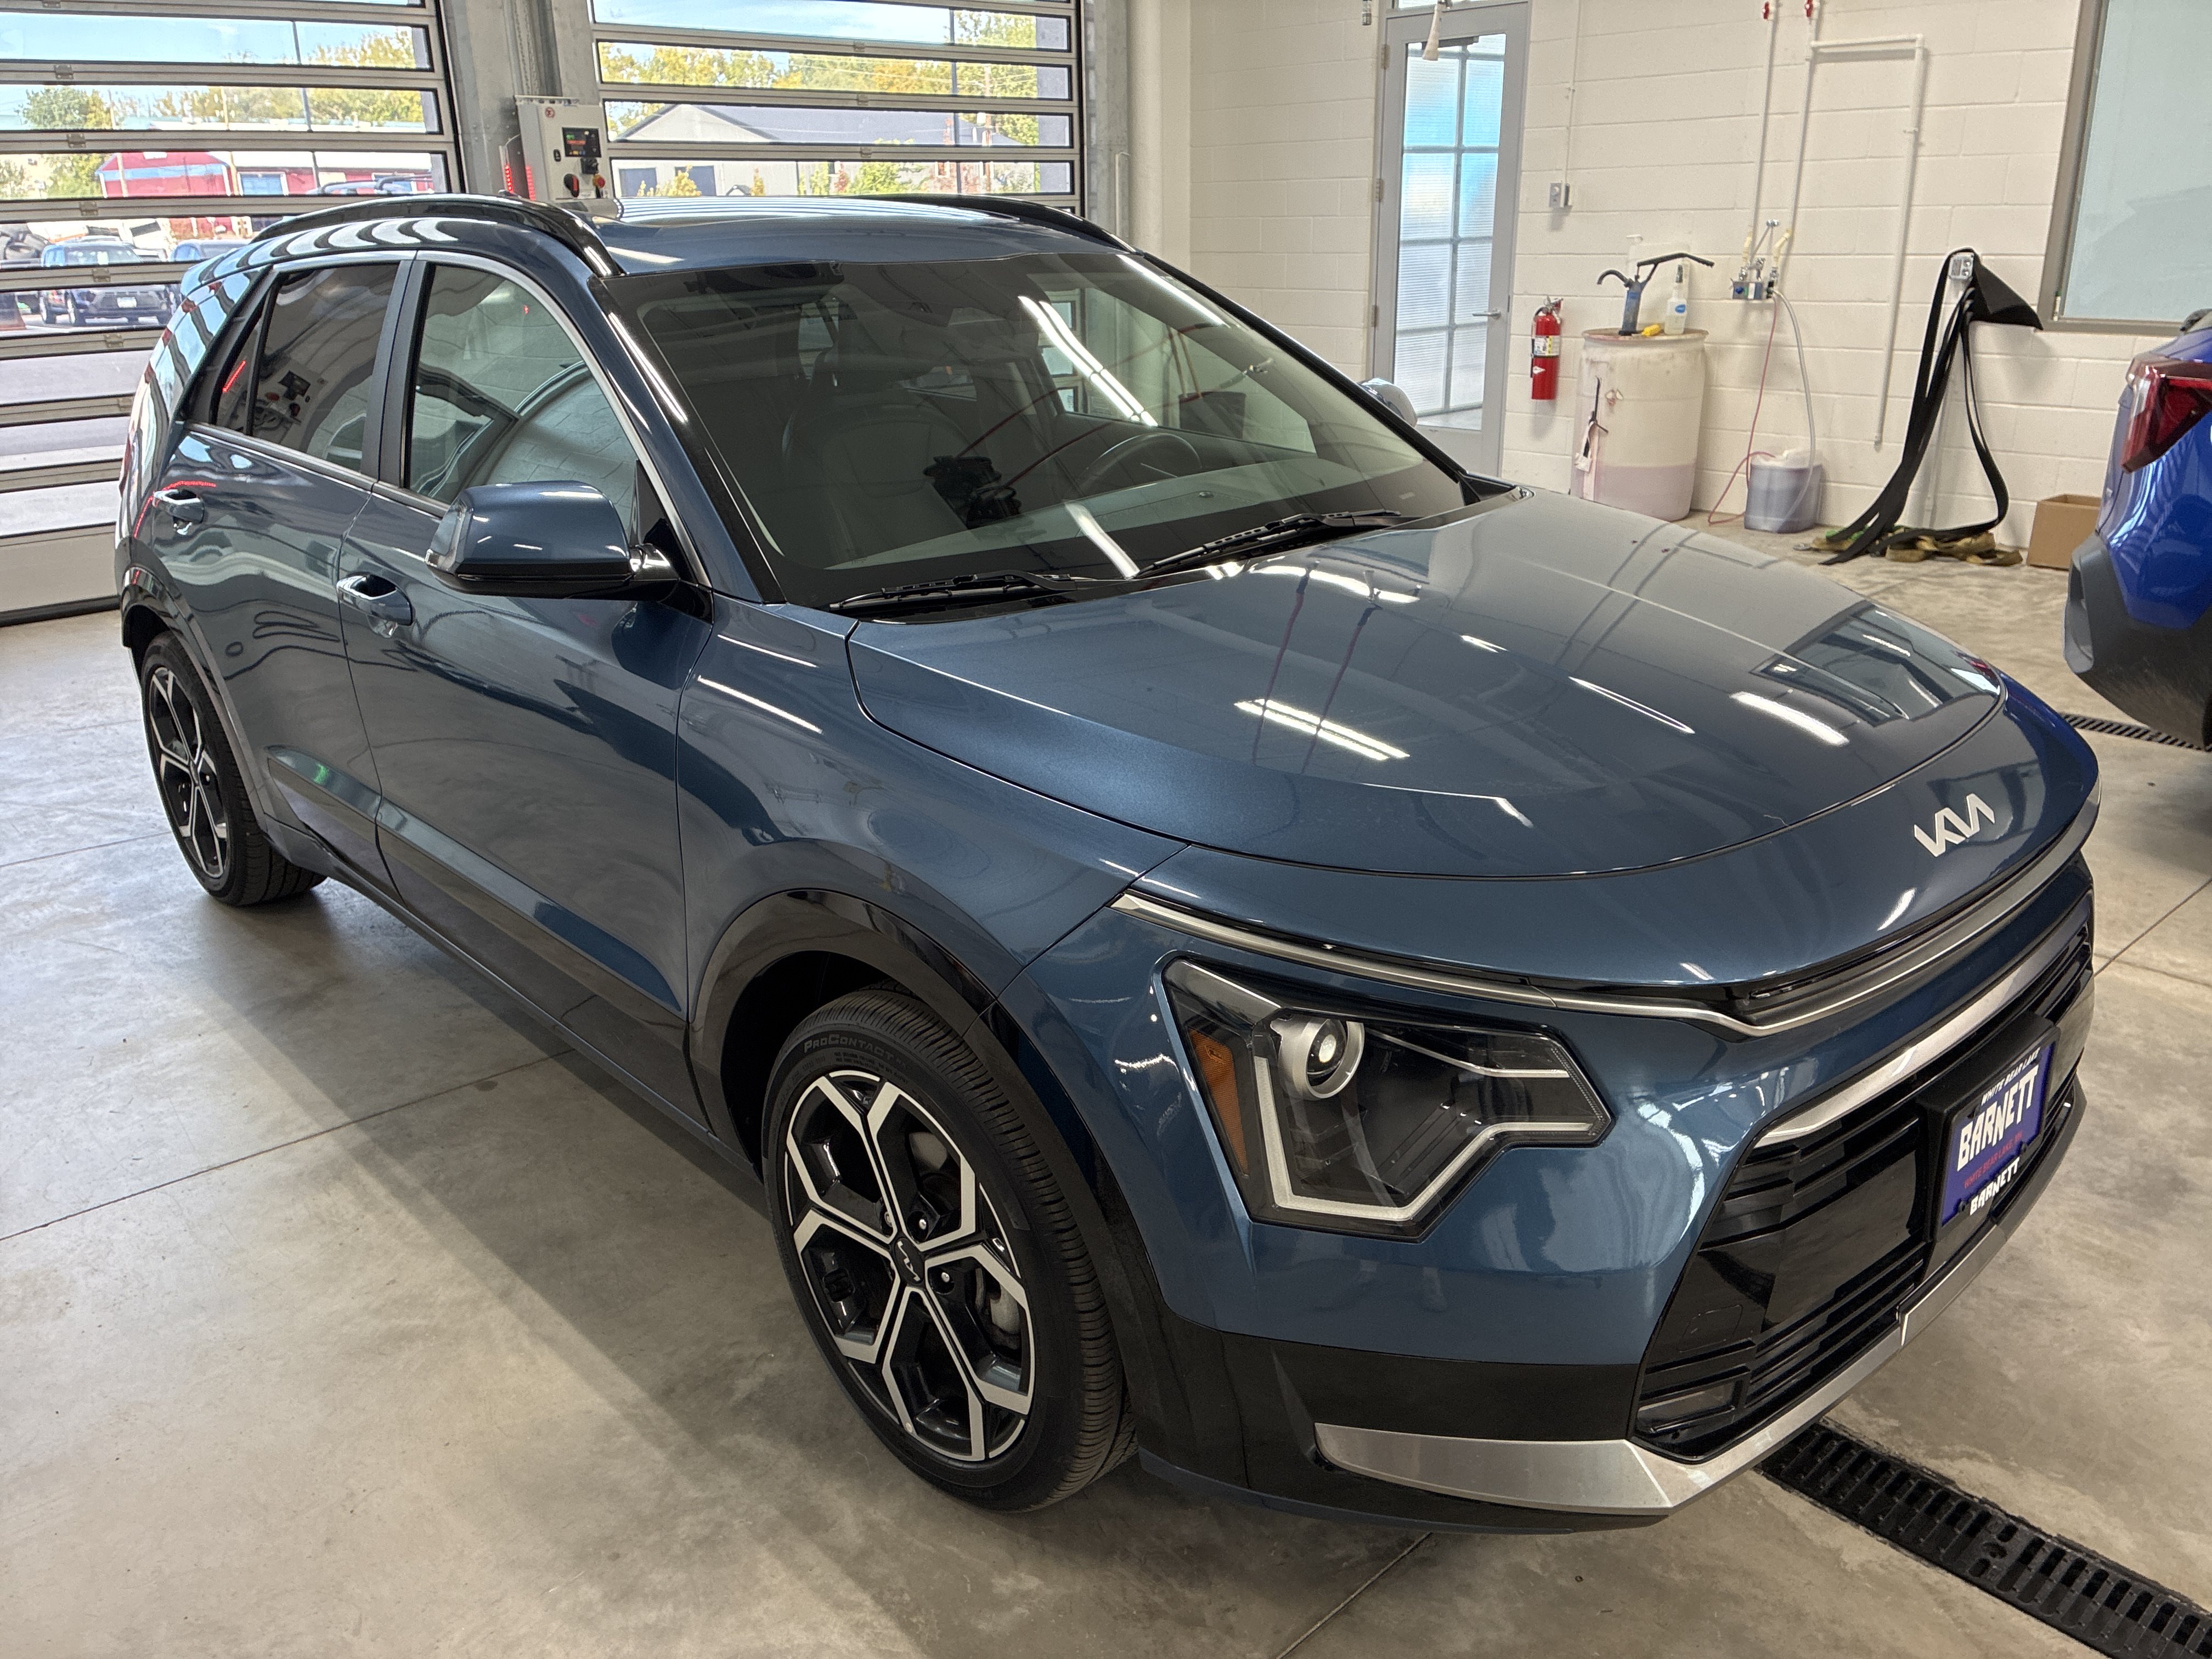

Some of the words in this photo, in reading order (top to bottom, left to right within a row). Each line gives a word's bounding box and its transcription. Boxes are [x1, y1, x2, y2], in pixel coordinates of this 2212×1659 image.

[1914, 793, 1996, 857] KIA
[1980, 1078, 2005, 1106] WHITE
[2004, 1062, 2023, 1087] BEAR
[1957, 1064, 2039, 1172] BARNETT
[1970, 1156, 2020, 1216] BARNETT
[1983, 1152, 1998, 1170] BEAR
